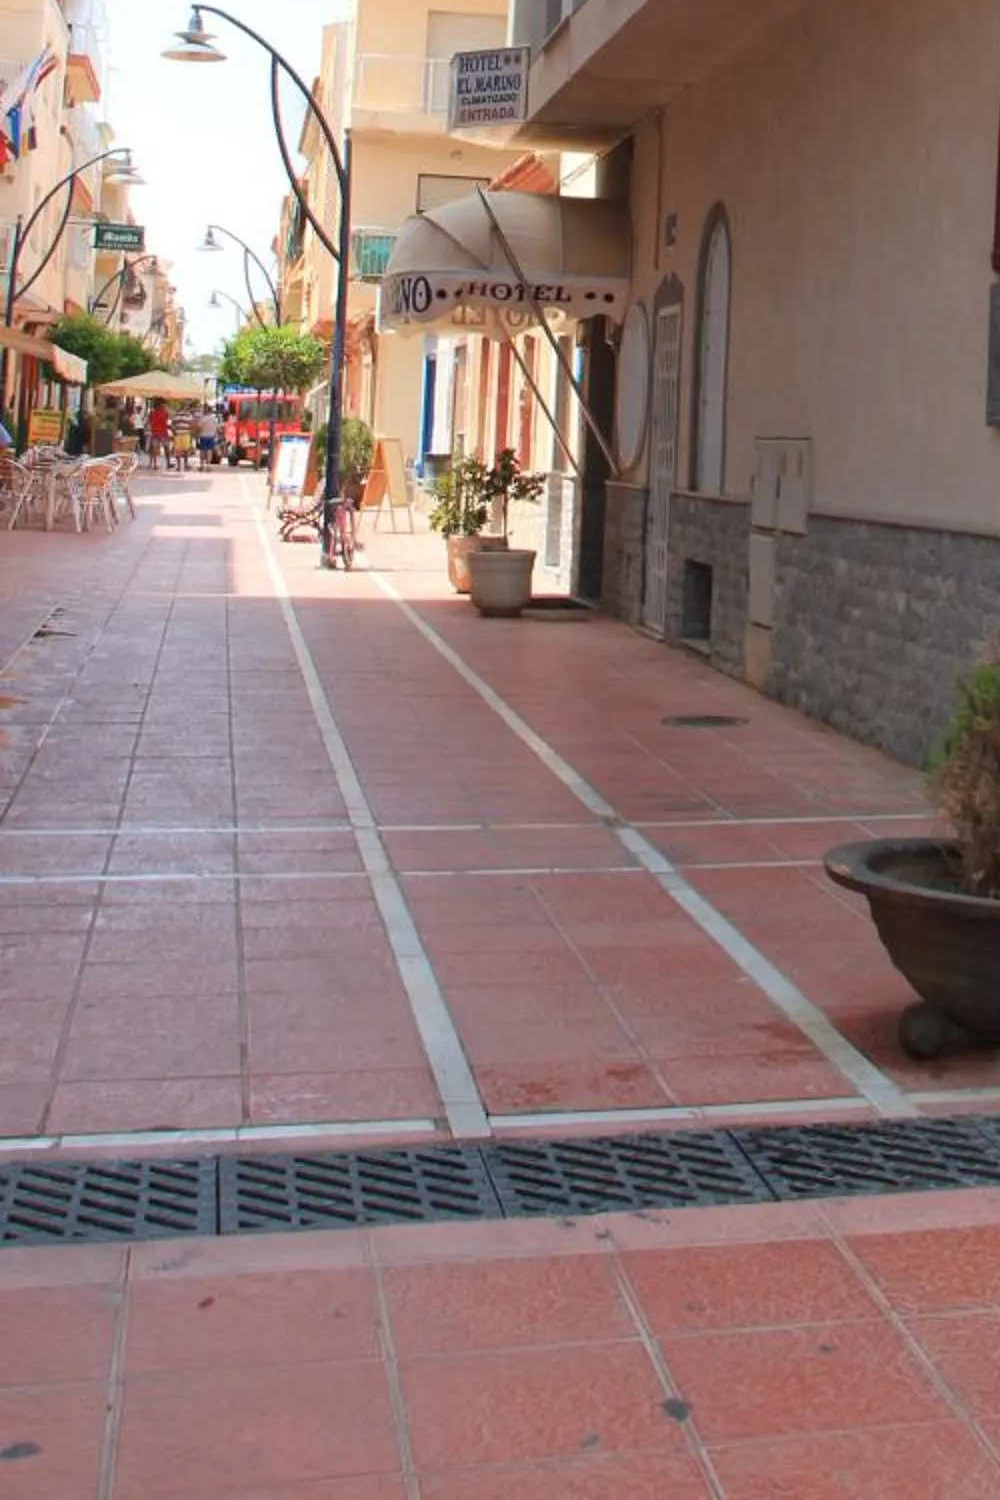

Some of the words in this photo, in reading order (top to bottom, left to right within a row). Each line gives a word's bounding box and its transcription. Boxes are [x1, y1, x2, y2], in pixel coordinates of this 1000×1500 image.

[459, 54, 502, 74] HOTEL
[457, 77, 472, 95] EL
[476, 74, 521, 93] MARINO
